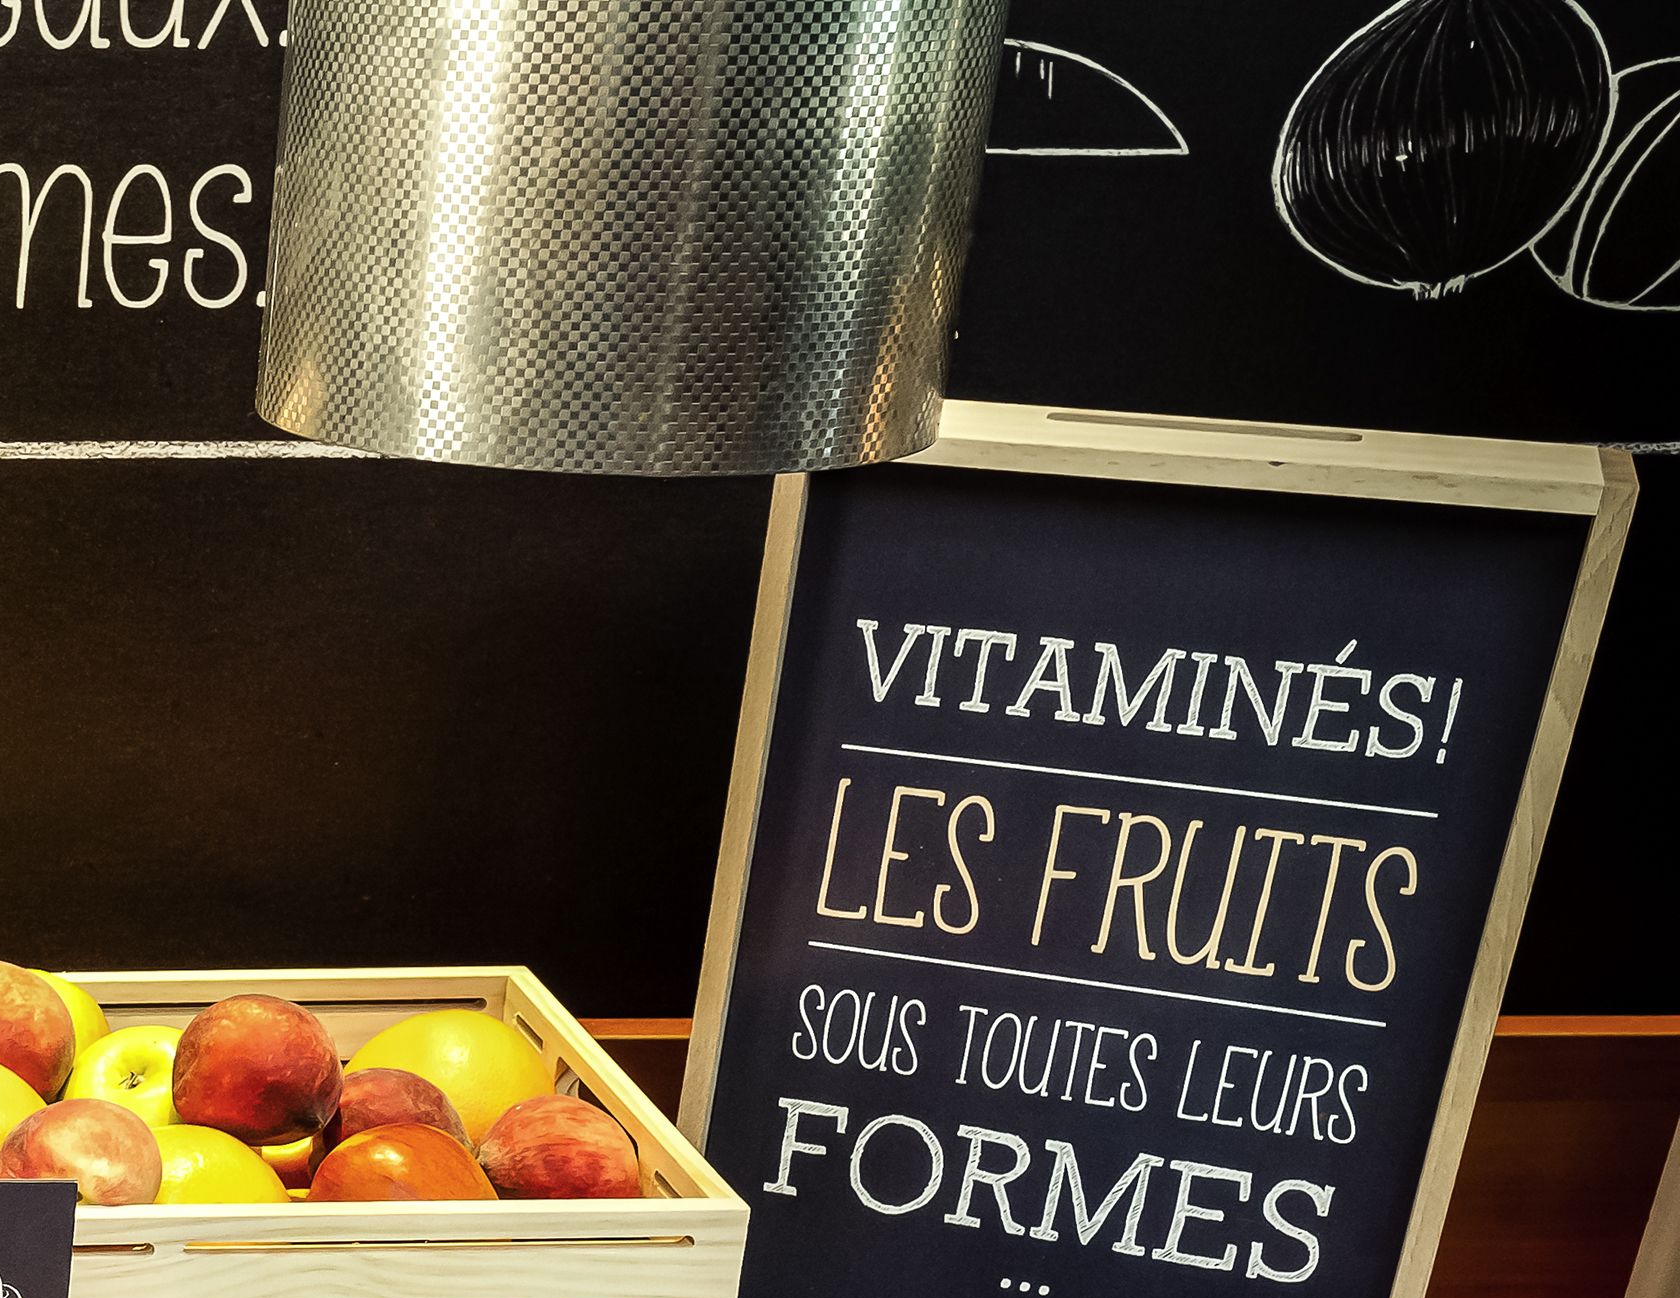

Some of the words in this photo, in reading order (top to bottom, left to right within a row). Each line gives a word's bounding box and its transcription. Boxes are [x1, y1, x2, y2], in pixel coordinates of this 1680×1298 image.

[856, 618, 1463, 766] VITAMINÉS!
[815, 778, 996, 935] LES
[1030, 804, 1418, 992] FRUITS
[791, 983, 927, 1077] SOUS
[953, 1003, 1158, 1114] TOUTES
[1176, 1038, 1369, 1146] LEURS
[762, 1097, 1335, 1284] FORMES
